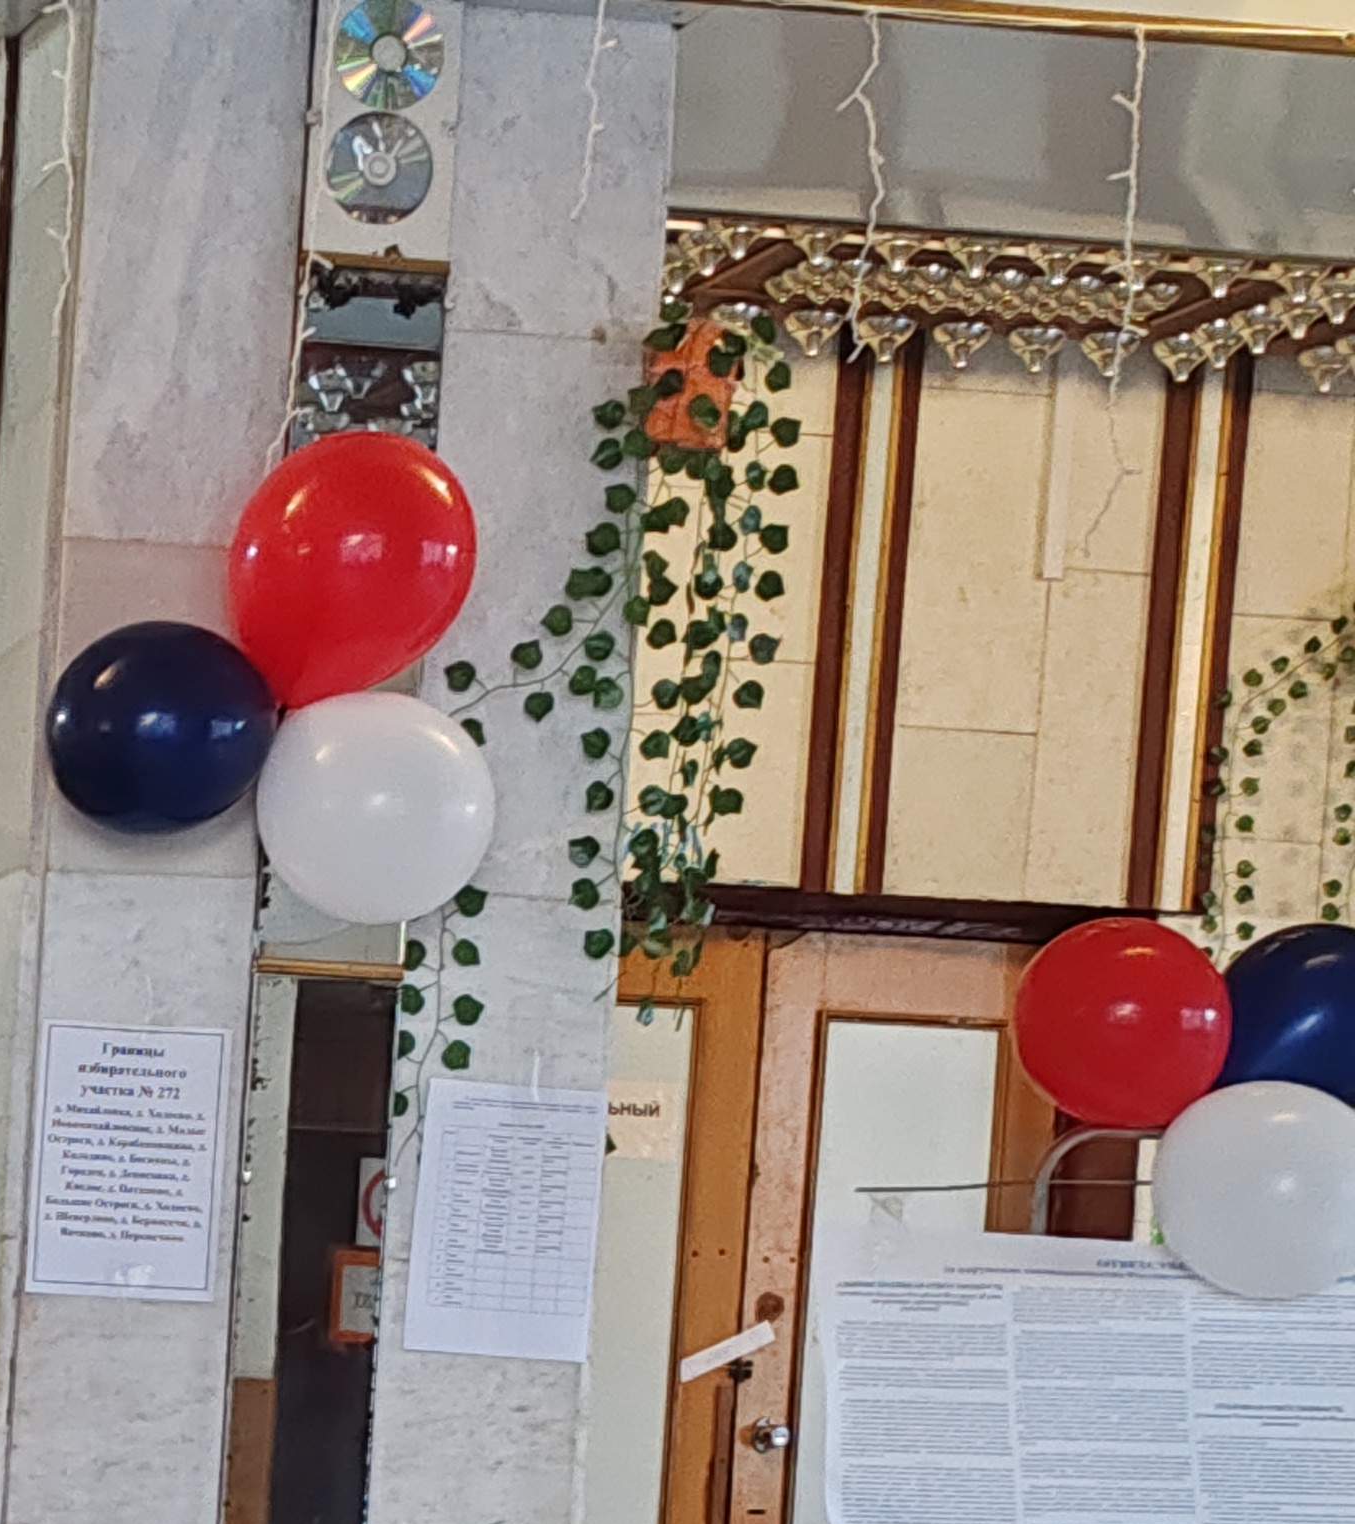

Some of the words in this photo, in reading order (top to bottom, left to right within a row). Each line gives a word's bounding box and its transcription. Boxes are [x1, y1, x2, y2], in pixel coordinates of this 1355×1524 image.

[102, 1041, 165, 1059] Границы
[78, 1062, 187, 1079] избирательного
[79, 1084, 135, 1098] участка
[156, 1087, 181, 1100] 272
